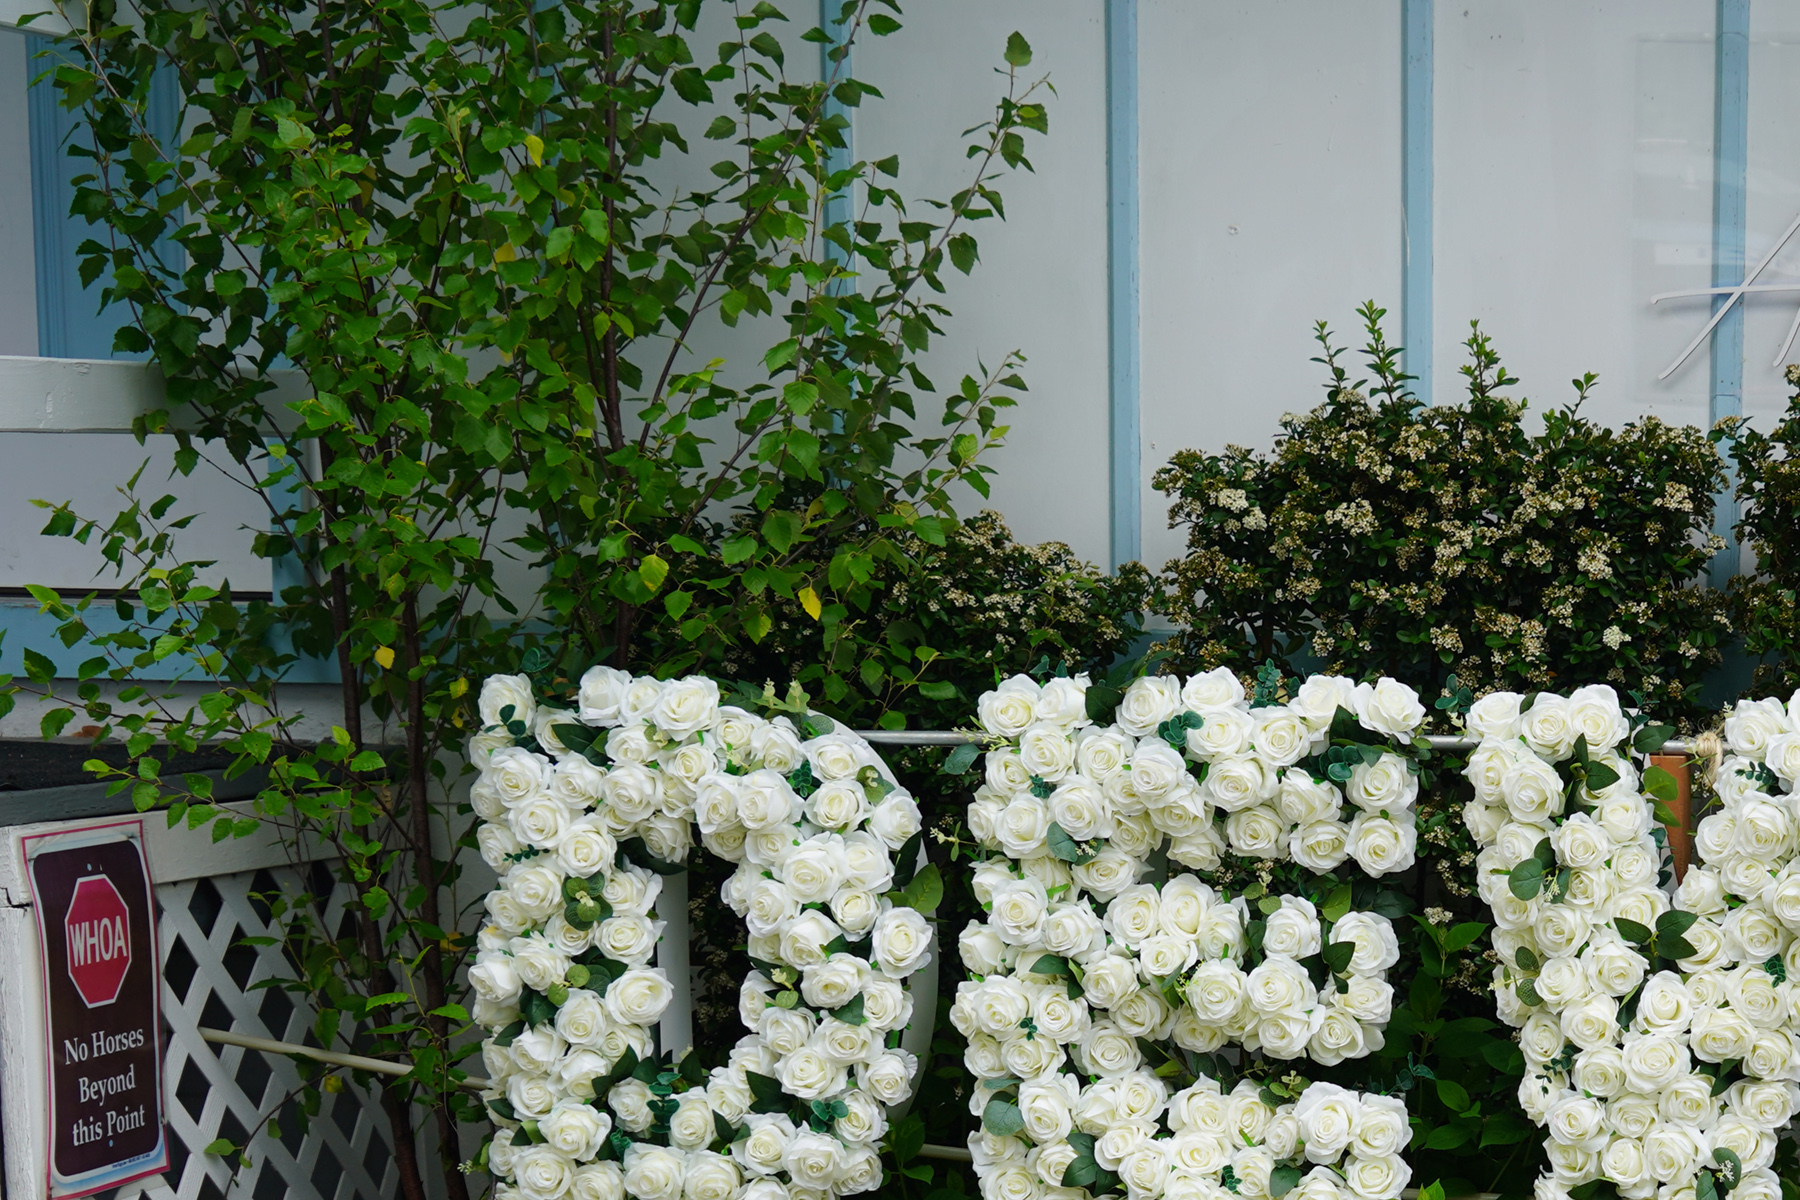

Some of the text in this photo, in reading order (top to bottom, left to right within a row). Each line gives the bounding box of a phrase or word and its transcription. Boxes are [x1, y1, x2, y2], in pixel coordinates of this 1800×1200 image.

[69, 915, 128, 967] WHOA
[64, 1028, 144, 1065] No Horses
[78, 1063, 136, 1107] Beyond
[72, 1104, 145, 1147] this Point
